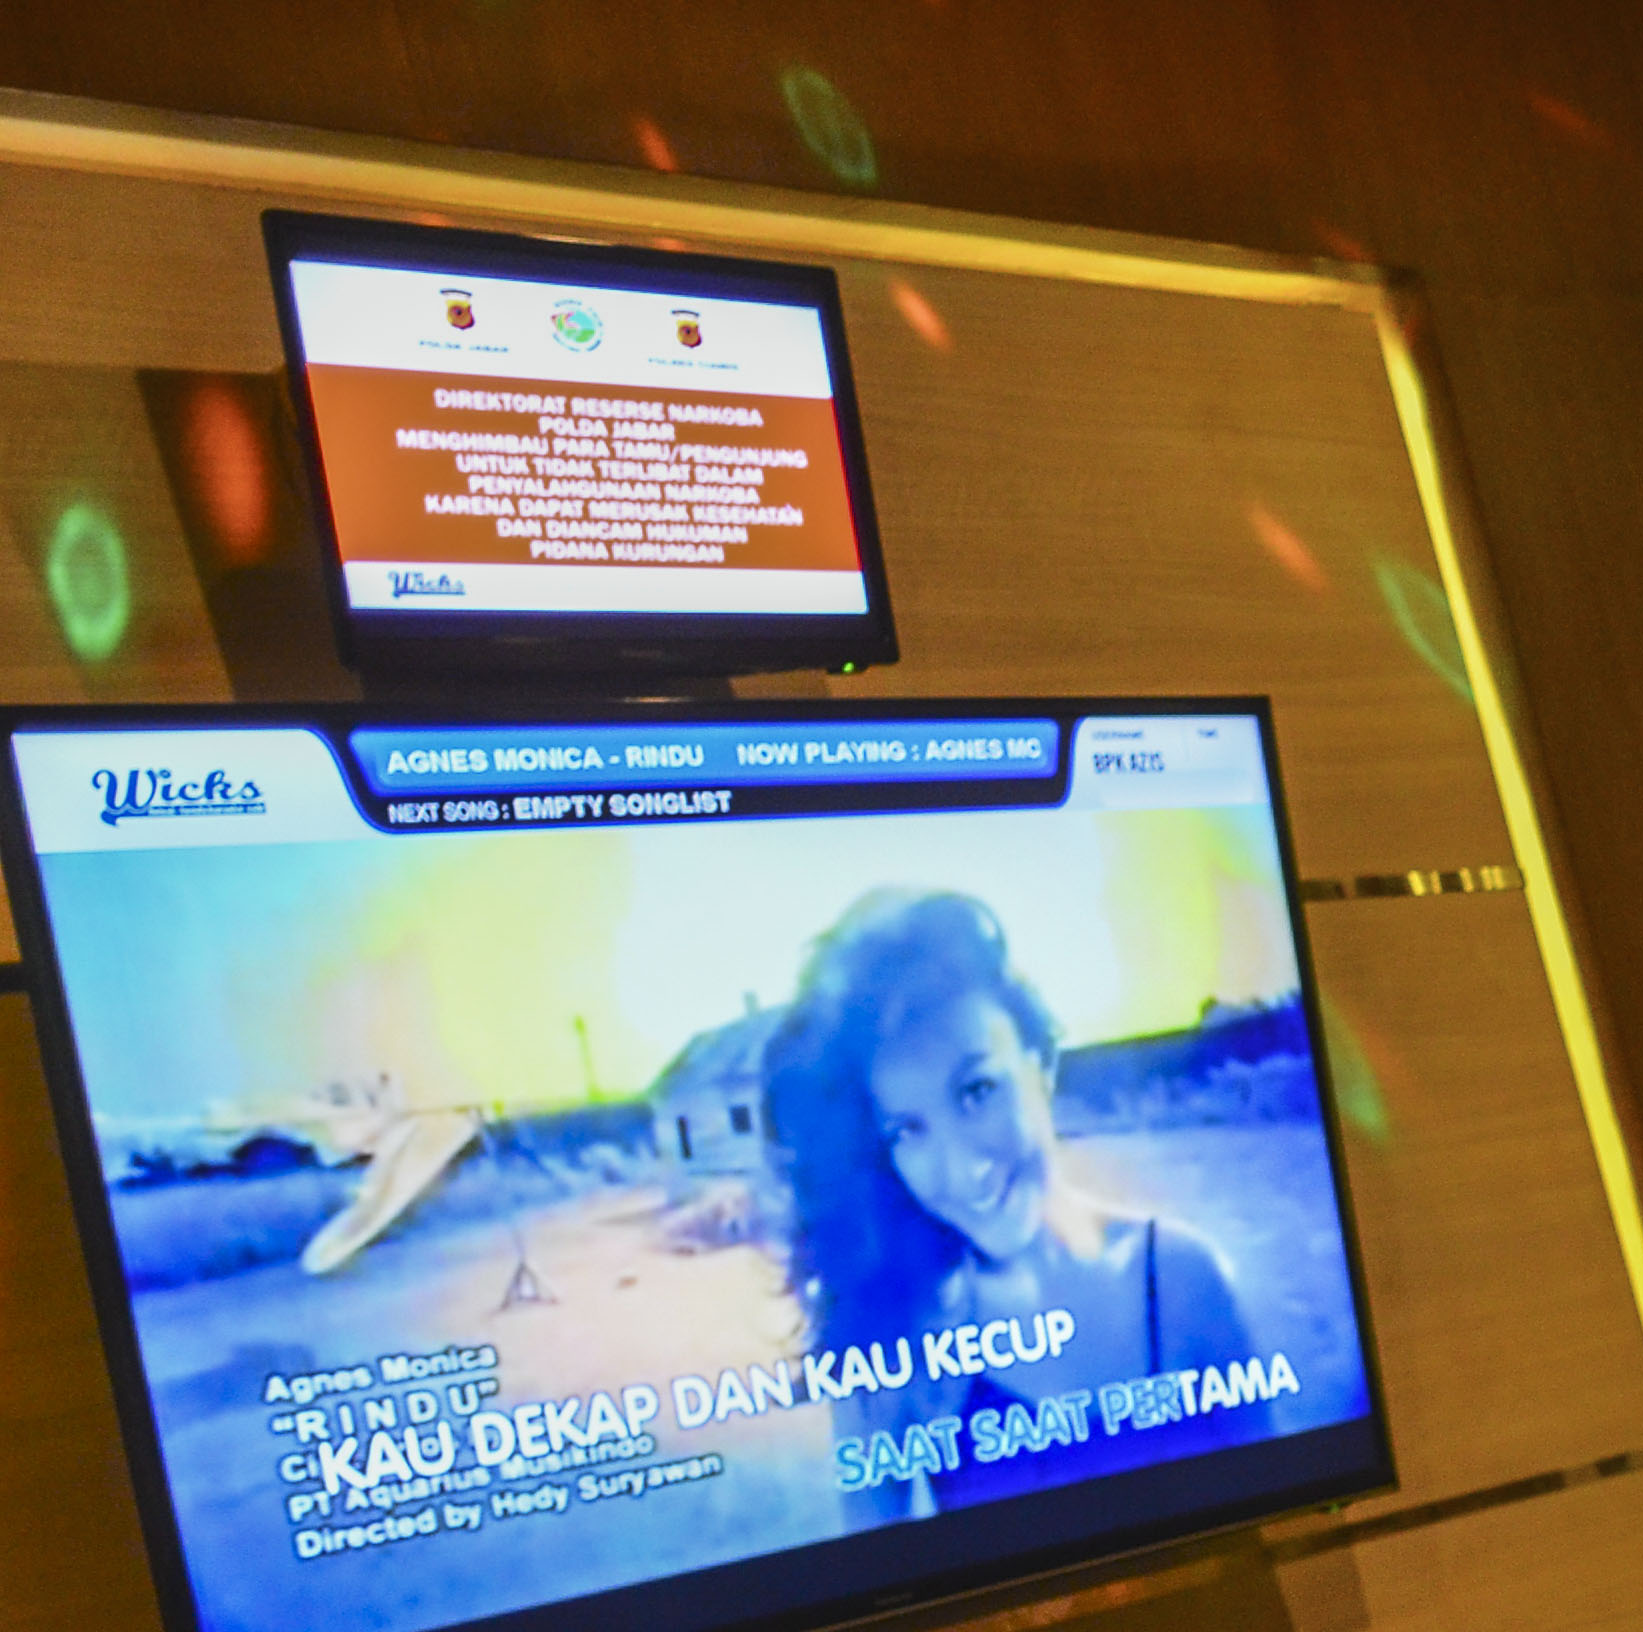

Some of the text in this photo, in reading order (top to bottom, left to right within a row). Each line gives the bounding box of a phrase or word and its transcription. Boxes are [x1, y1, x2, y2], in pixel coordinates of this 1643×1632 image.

[434, 388, 763, 427] DIREKTORAT RESERSE NARKOBA
[539, 416, 675, 441] POLDA JABAR
[396, 429, 808, 468] MENGHIMBAU PARA TAMU/PENGUNJUNG
[456, 453, 763, 485] UNTUK TIDAK TERLIBAT DALAM
[468, 475, 760, 504] PENYALAHGUNAAN NARKOBA
[424, 494, 803, 526] KARENA DAPAT MERUSAK KESEHATAN
[497, 518, 748, 543] DAN DIANCAM HUKUMAN
[530, 540, 724, 563] PIDANA KURUNGAN
[387, 749, 488, 775] AGNES
[493, 747, 604, 771] MONICA
[625, 744, 704, 768] RINDU
[736, 741, 798, 766] NOW
[804, 739, 907, 765] PLAYING
[925, 738, 1004, 762] AGNES
[91, 768, 263, 811] Wicks
[387, 802, 440, 824] NEXT
[442, 800, 499, 823] SONG
[512, 794, 604, 821] EMPTY
[608, 789, 733, 817] SONGLIST
[265, 1345, 498, 1403] Agnes Monica
[318, 1420, 456, 1496] KAU
[469, 1384, 659, 1468] DEKAP
[672, 1361, 793, 1430] DAN
[804, 1336, 914, 1403] KAU
[923, 1309, 1077, 1380] KECUP
[834, 1352, 1300, 1493] SAAT SAAT PERTAMA
[288, 1491, 333, 1522] PT
[345, 1463, 491, 1512] Aquarius
[295, 1452, 724, 1560] Directed by Hedy Suryawan
